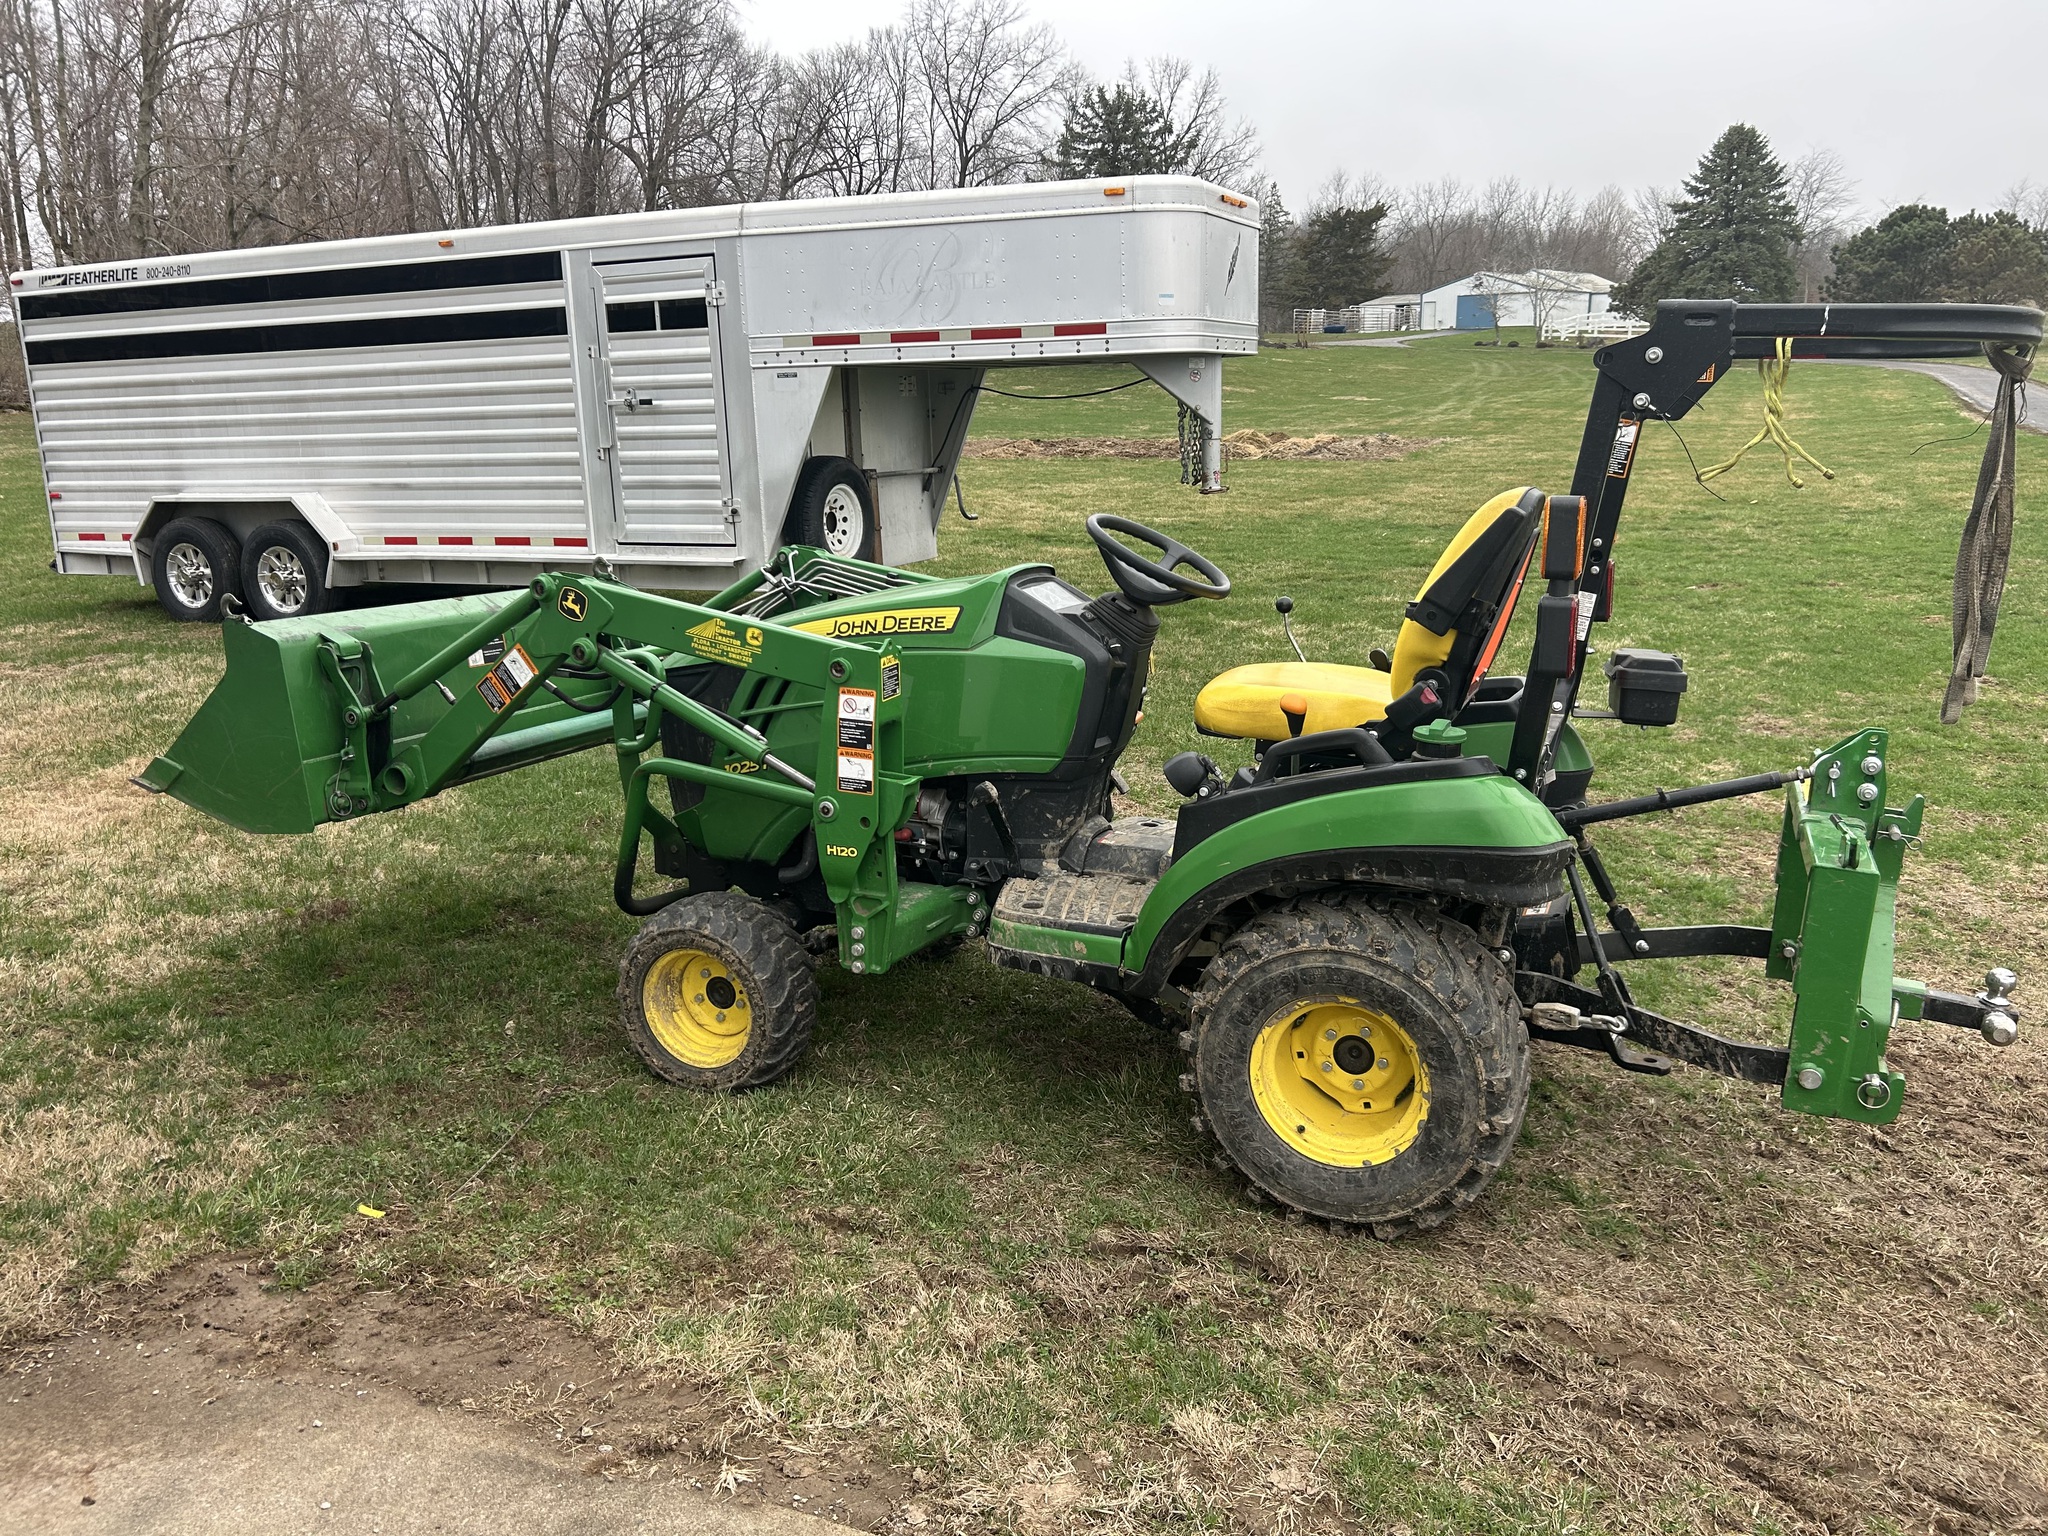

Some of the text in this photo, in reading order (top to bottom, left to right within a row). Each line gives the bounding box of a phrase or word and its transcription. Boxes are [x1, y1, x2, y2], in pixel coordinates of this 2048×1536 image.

[68, 264, 191, 286] FEATHERLITE 800-240-8110
[826, 615, 947, 636] JOHN DEERE
[691, 642, 723, 655] FRANKFORT
[693, 637, 711, 646] FLORA
[716, 643, 752, 657] LOGANSPORT
[846, 689, 875, 697] WARNING
[844, 751, 872, 759] WARNING
[826, 844, 858, 857] H120
